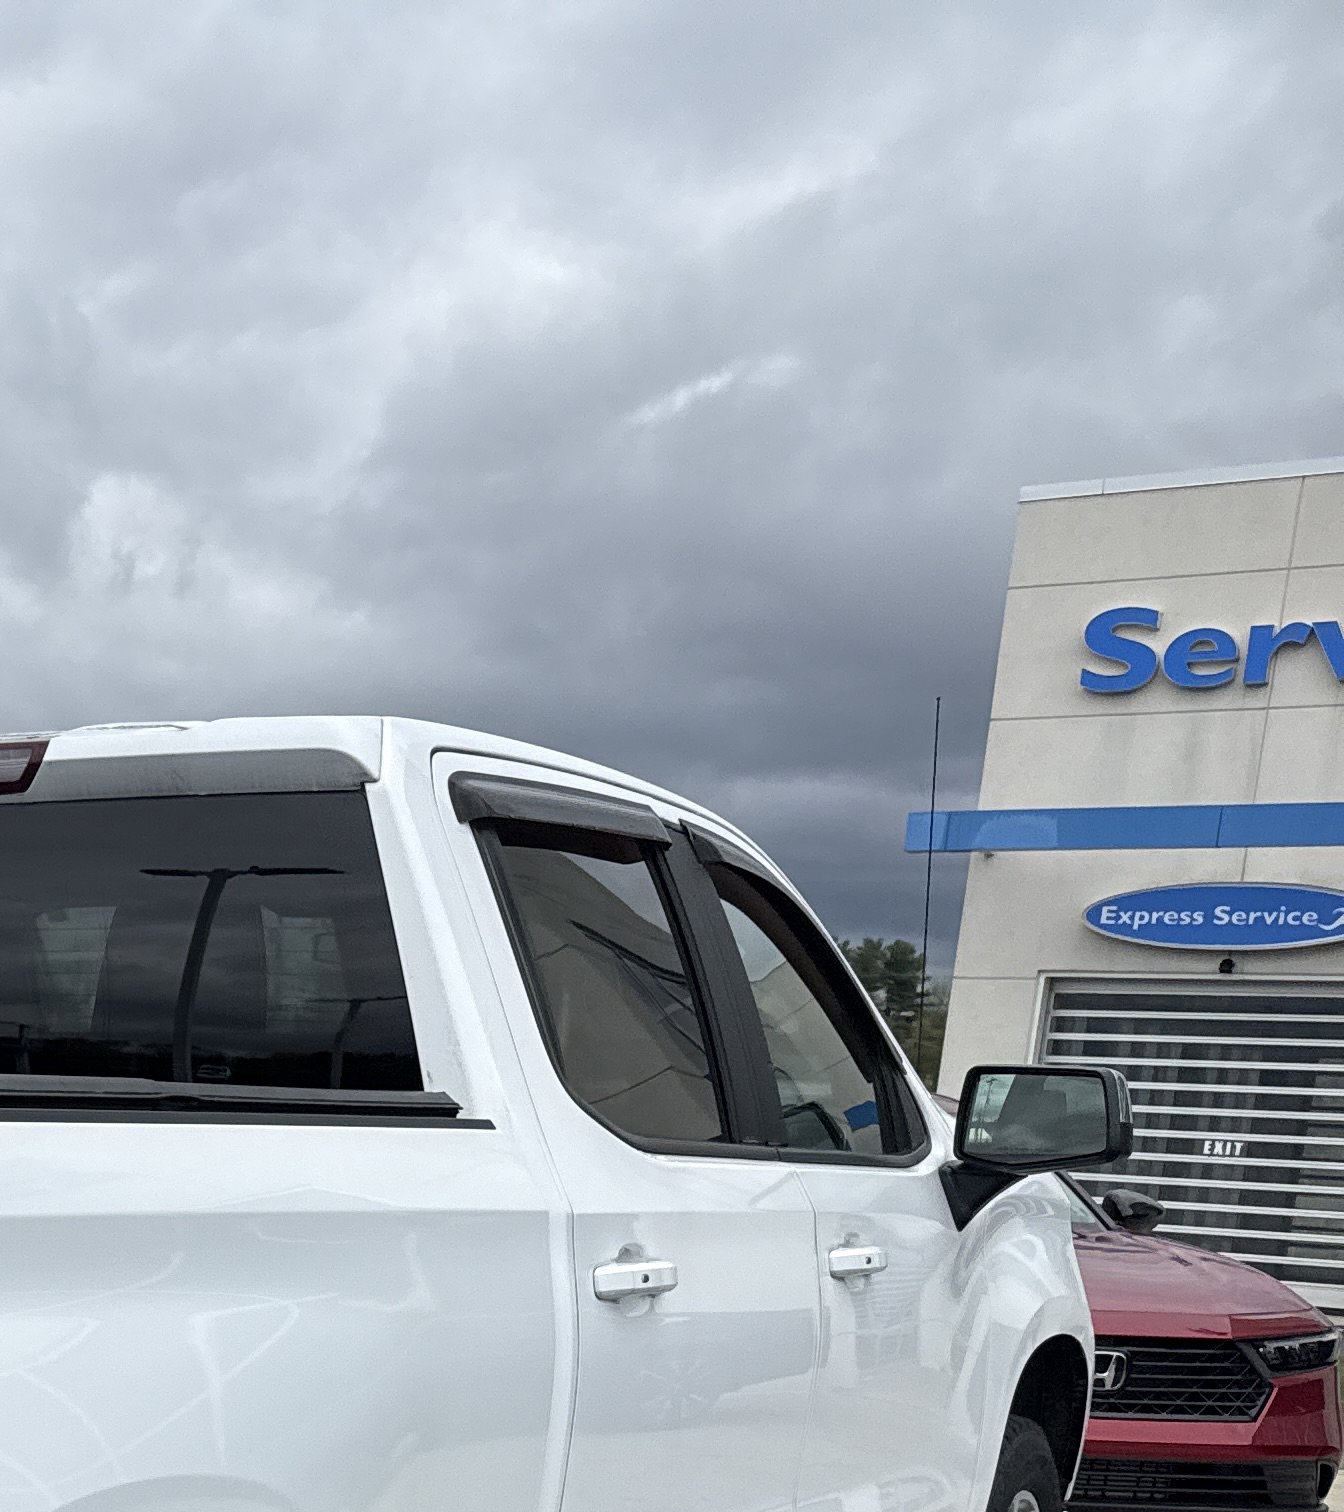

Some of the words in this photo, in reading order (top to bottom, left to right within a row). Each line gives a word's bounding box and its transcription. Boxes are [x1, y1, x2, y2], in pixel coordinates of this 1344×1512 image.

[1100, 905, 1205, 930] Express
[1213, 905, 1319, 926] Service
[1203, 1140, 1245, 1156] EXIT
